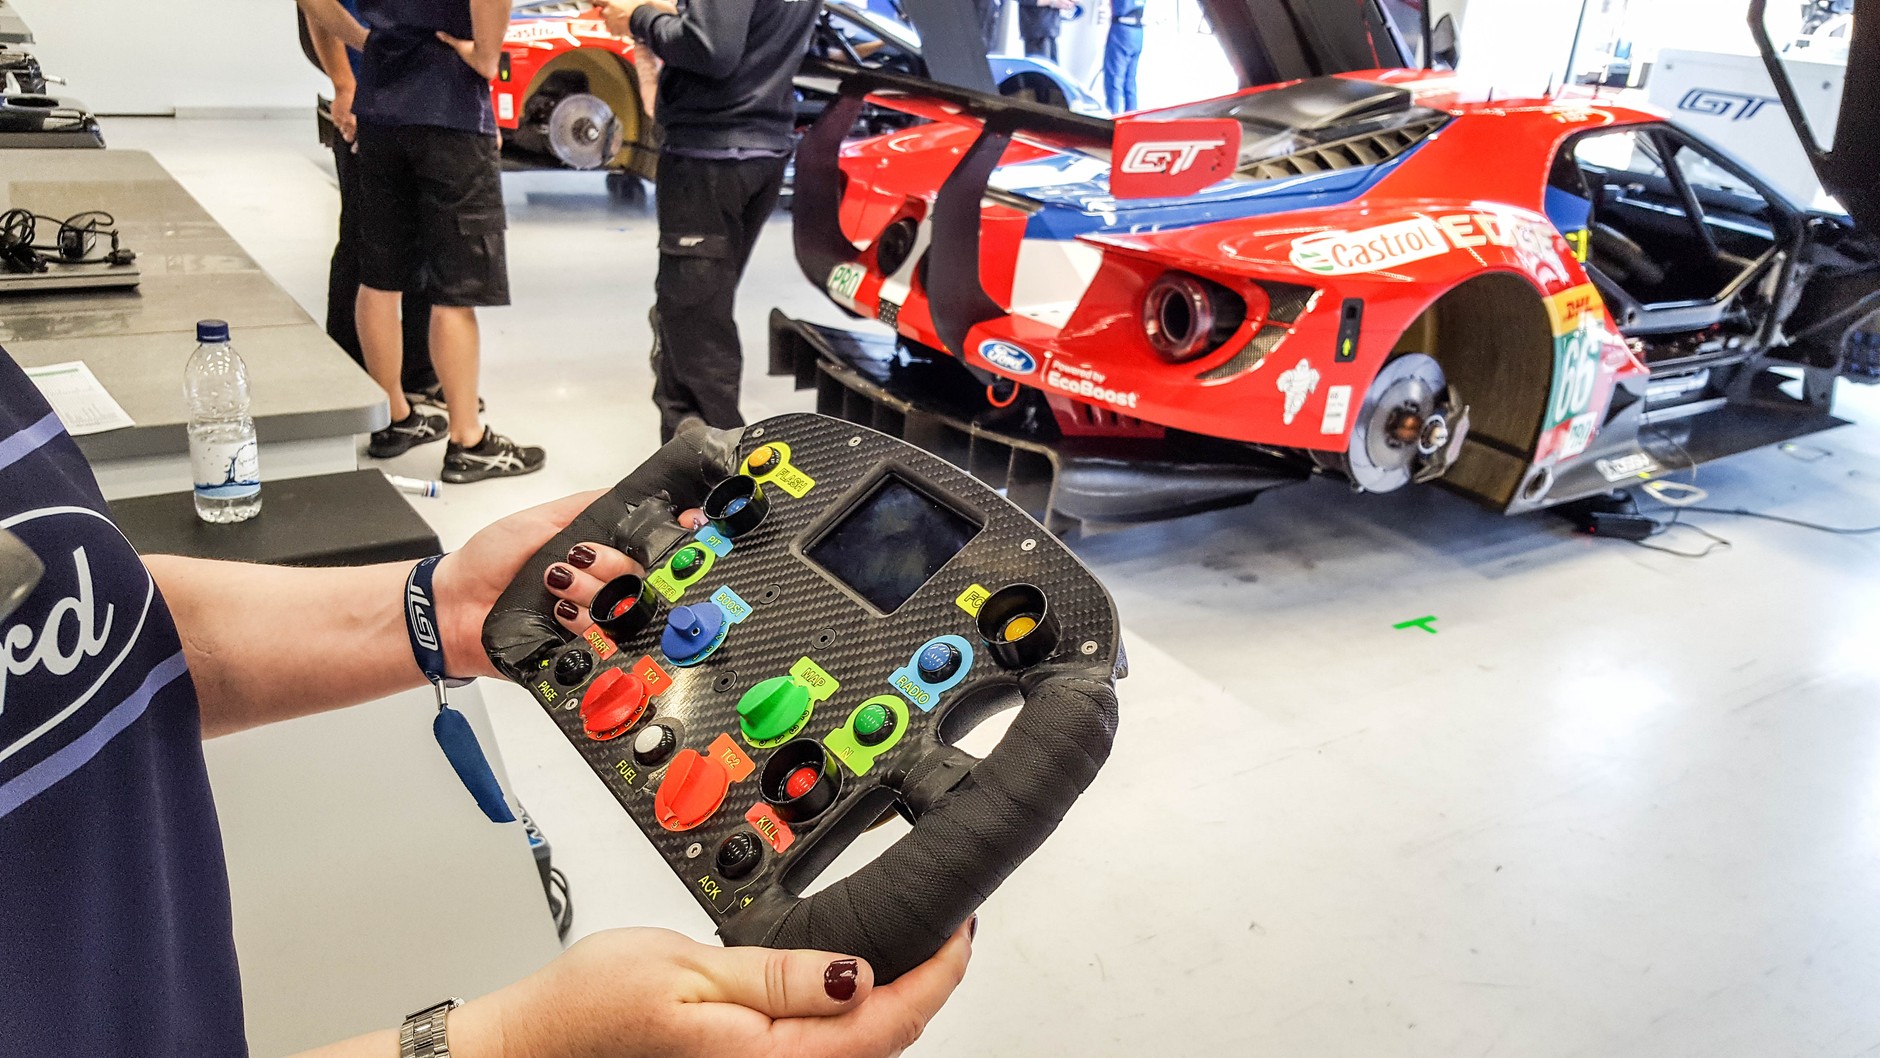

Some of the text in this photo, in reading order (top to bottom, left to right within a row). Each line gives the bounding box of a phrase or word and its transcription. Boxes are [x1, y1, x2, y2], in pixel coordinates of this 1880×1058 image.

[1678, 87, 1781, 121] GT
[1121, 140, 1226, 175] GT
[1331, 225, 1436, 268] Castrol
[829, 266, 860, 299] PRO
[984, 342, 1031, 373] Ford
[1052, 360, 1106, 384] Powered by
[1555, 334, 1600, 422] 66
[1047, 370, 1138, 409] EcoBoost
[775, 468, 808, 492] FLASH
[706, 535, 722, 548] PIT
[652, 575, 677, 599] WIPER
[716, 592, 745, 617] BOOST
[588, 631, 610, 654] START
[643, 667, 660, 685] TC1
[800, 667, 826, 687] MAP
[537, 680, 558, 702] PAGE
[896, 675, 929, 704] RADIO
[721, 747, 741, 769] TC2
[841, 746, 854, 760] N
[615, 759, 638, 785] FUEL
[755, 815, 780, 841] KILL
[698, 875, 722, 900] ACK
